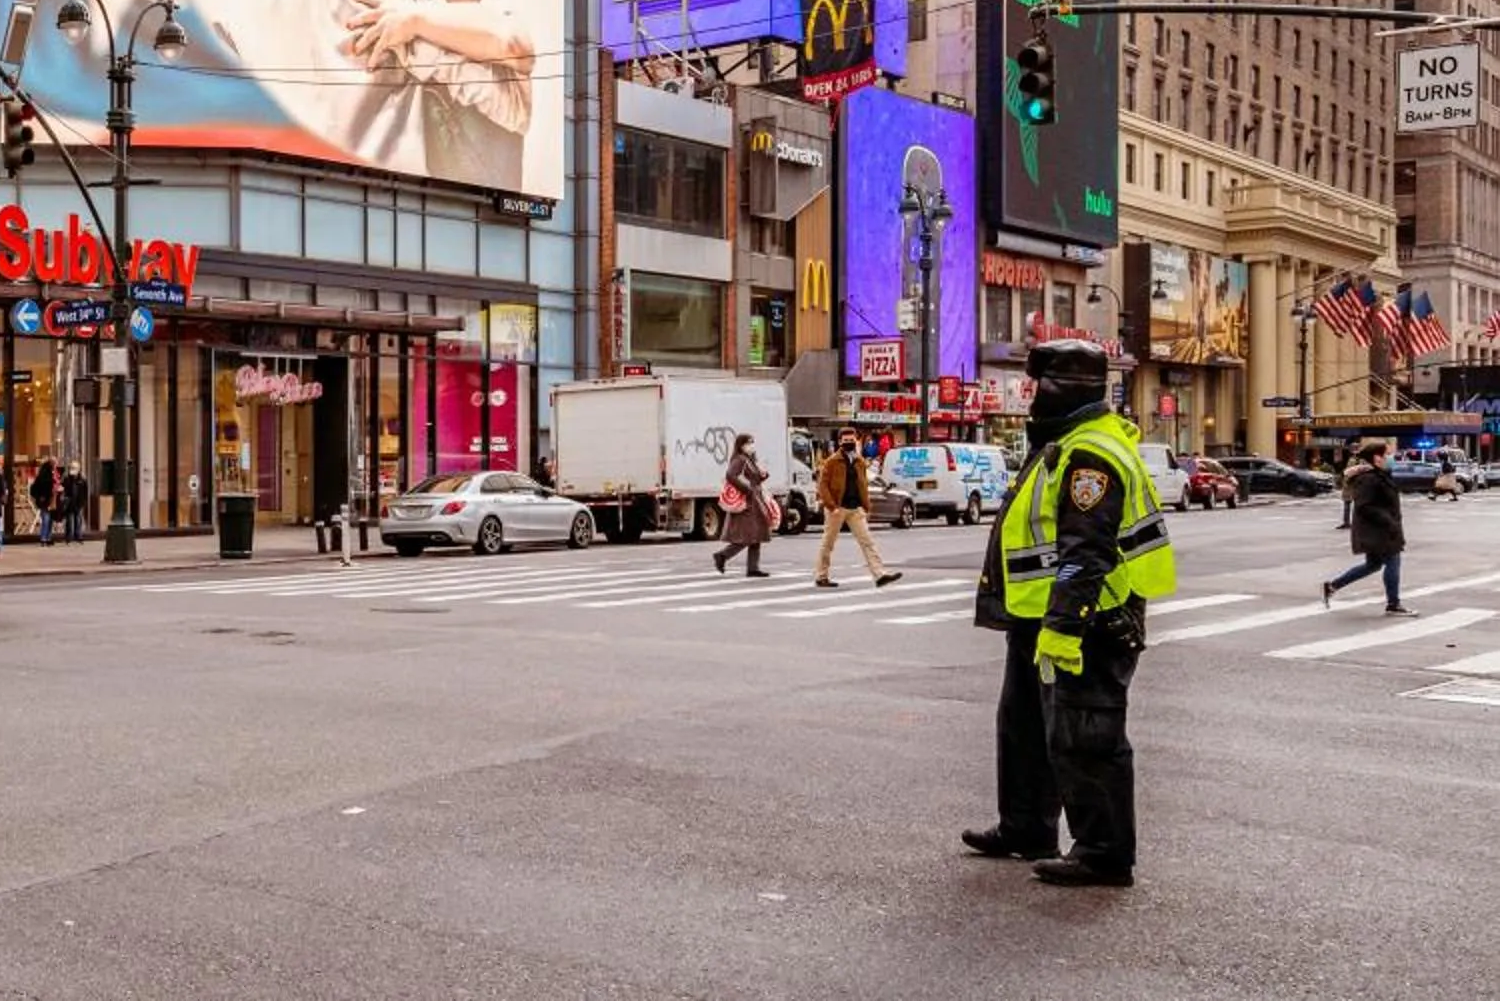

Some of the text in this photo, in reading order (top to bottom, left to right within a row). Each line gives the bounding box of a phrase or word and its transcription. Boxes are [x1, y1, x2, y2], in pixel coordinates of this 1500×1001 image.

[1419, 55, 1458, 78] NO
[804, 81, 833, 98] OPEN
[1403, 81, 1474, 104] TURNS
[1084, 186, 1113, 218] hulu
[983, 251, 1044, 290] HOOTERS
[133, 286, 185, 303] Seventh Ave
[55, 310, 78, 323] West
[95, 306, 106, 319] St
[863, 355, 897, 376] PIZZA
